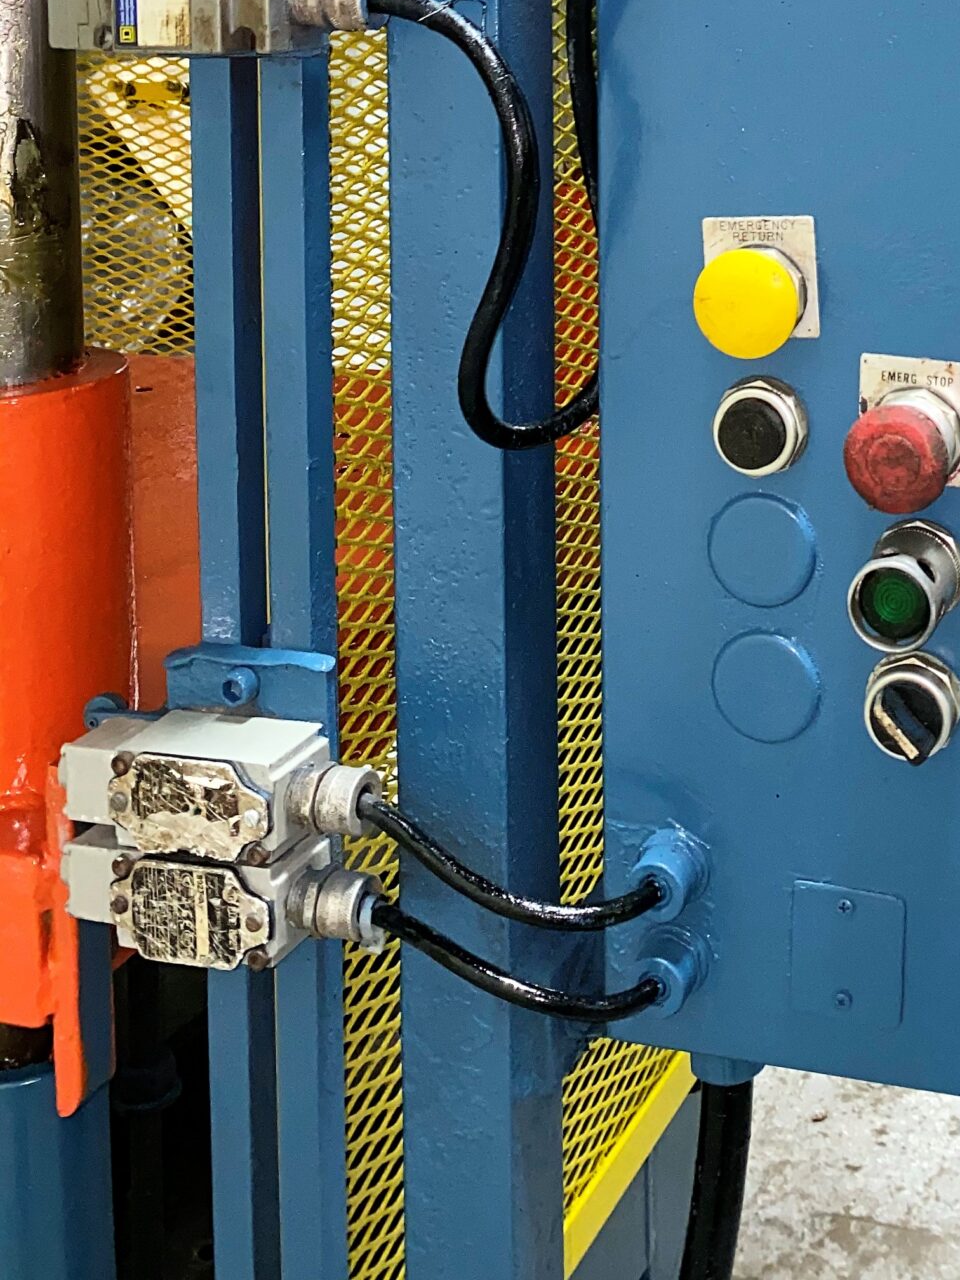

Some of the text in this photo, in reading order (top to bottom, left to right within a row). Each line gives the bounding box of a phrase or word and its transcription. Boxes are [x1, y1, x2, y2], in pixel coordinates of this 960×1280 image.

[720, 220, 795, 231] EMERGENCY
[733, 231, 783, 241] RETURN
[881, 370, 917, 384] EMERG
[926, 375, 954, 388] STOP
